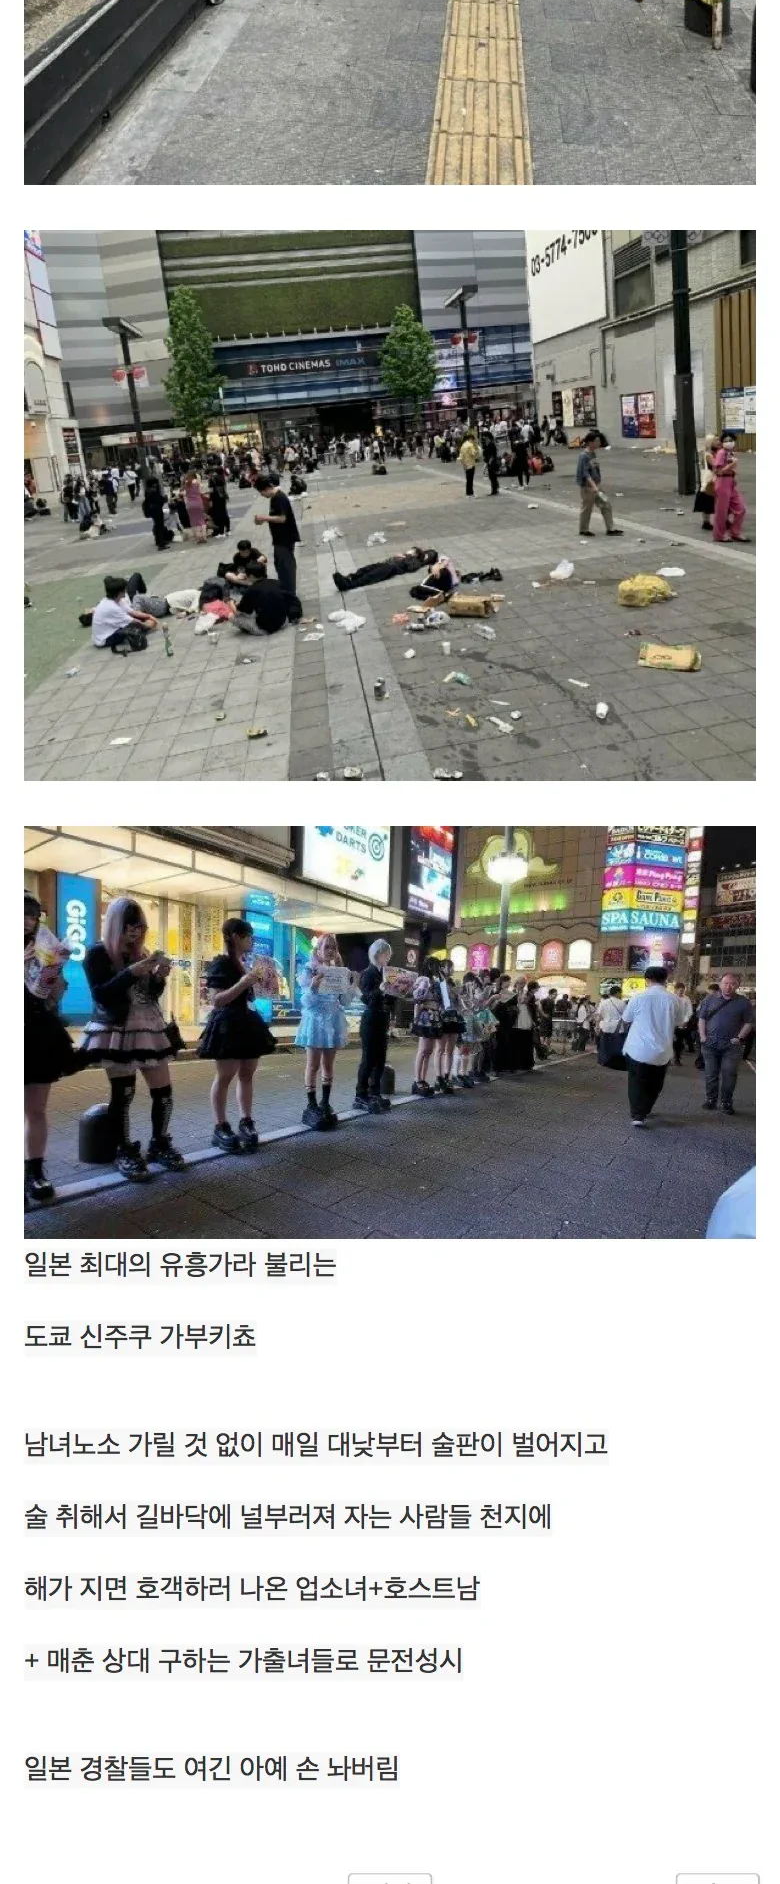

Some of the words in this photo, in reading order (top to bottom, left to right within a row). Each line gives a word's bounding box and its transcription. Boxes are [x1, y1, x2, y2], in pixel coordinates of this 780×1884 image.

[260, 364, 287, 373] TOHO
[288, 359, 331, 371] CINEMAS
[335, 357, 366, 367] IMAX
[335, 831, 367, 854] DARTS
[601, 910, 629, 926] SPA
[630, 910, 680, 929] SAUNA
